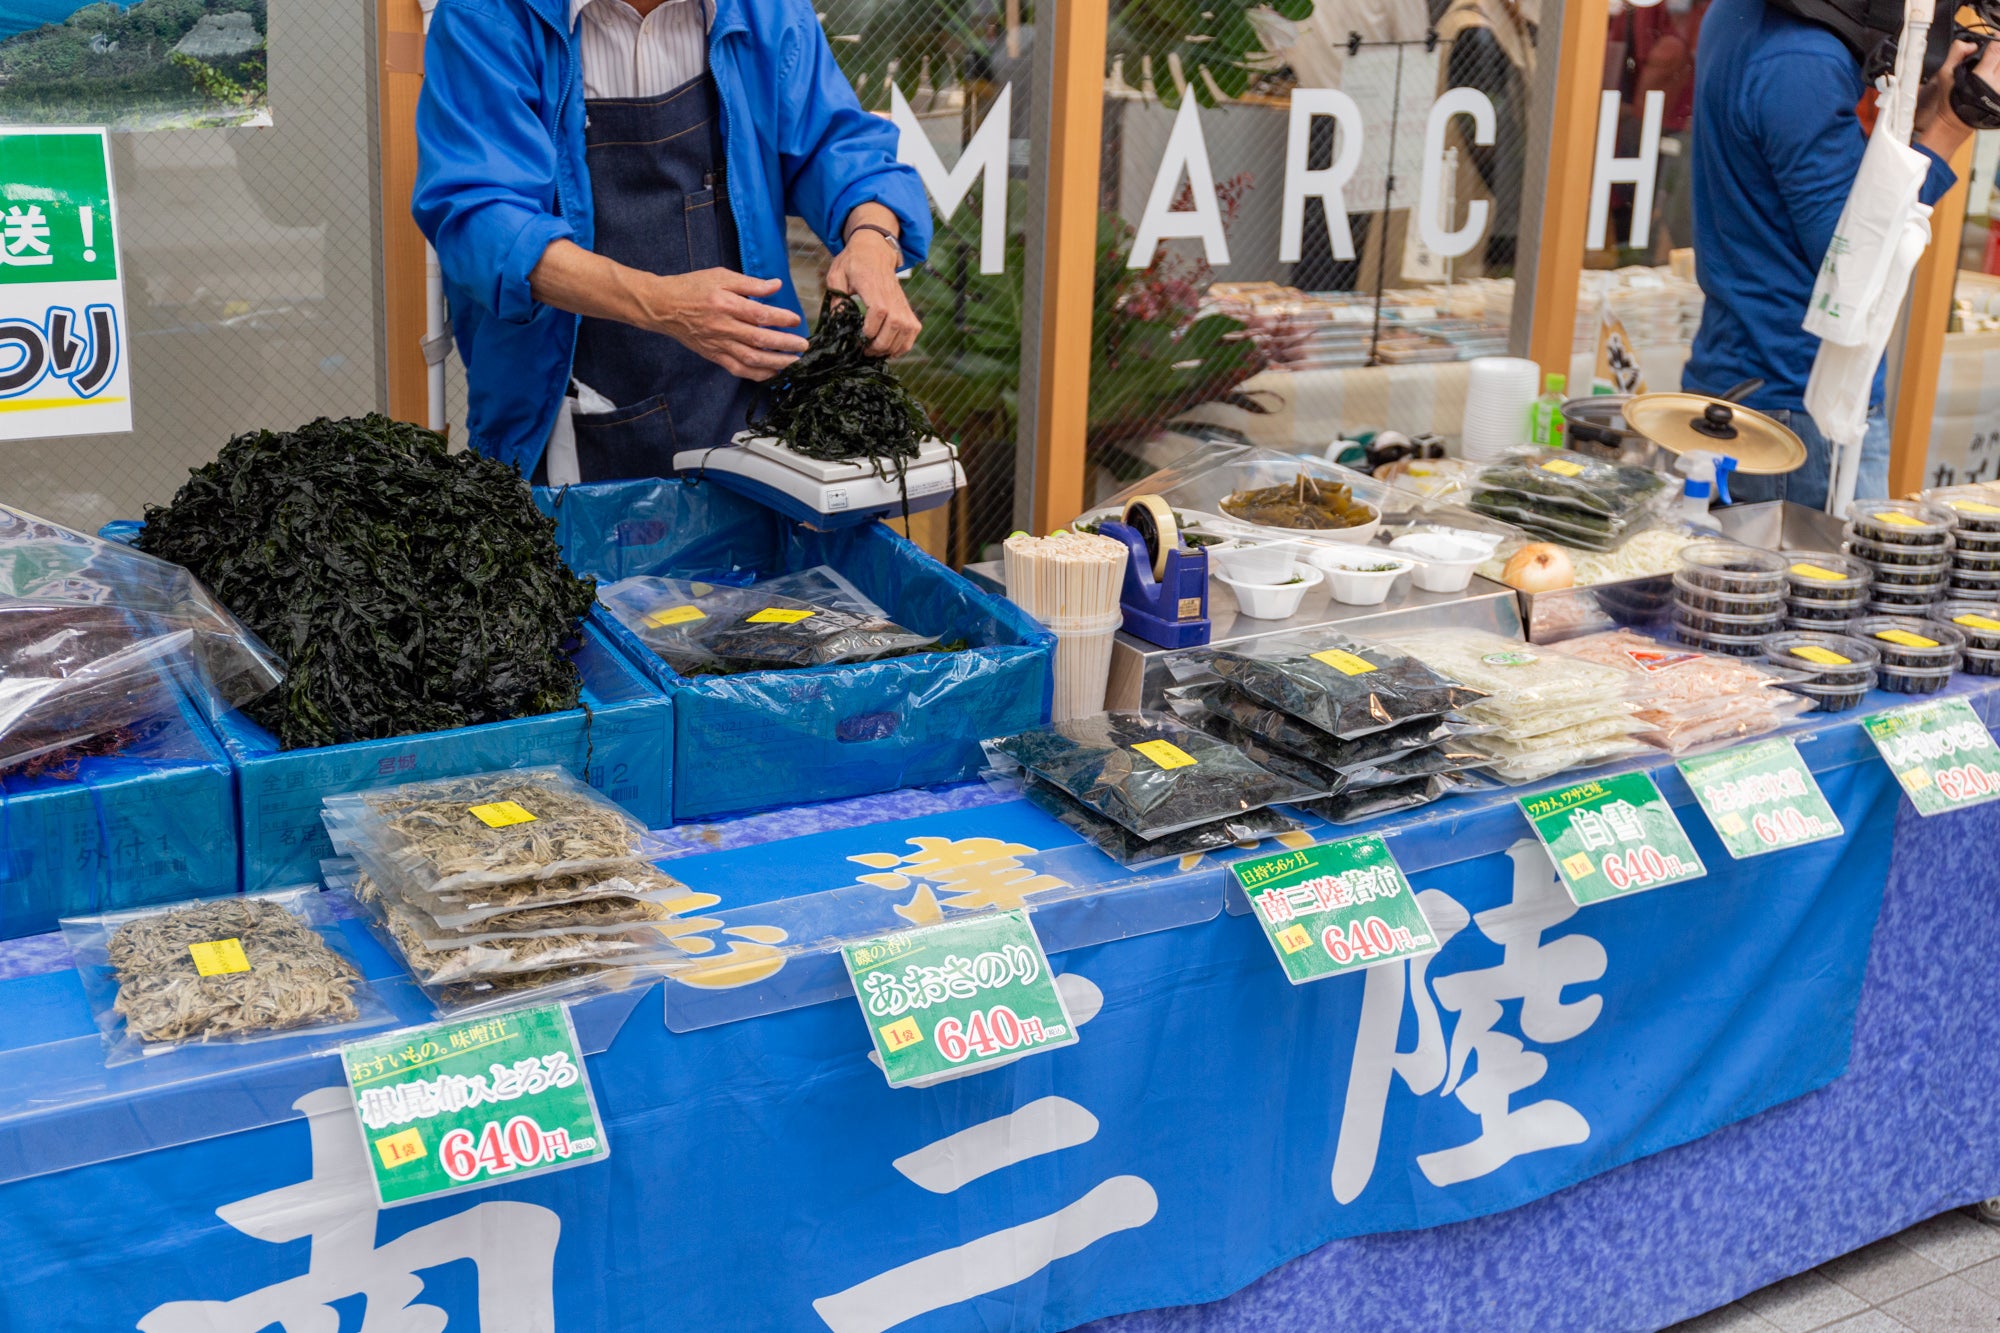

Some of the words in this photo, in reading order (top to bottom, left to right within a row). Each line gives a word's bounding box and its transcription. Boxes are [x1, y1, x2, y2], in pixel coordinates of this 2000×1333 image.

[1569, 799, 1646, 851] 白雪
[1256, 867, 1400, 923] 南三陸若布
[854, 934, 912, 966] 磯の香り
[864, 945, 1038, 1015] あおさのり
[889, 1029, 915, 1046] 1袋
[359, 1052, 578, 1128] 根昆布入とろろ
[387, 1141, 416, 1161] 1袋
